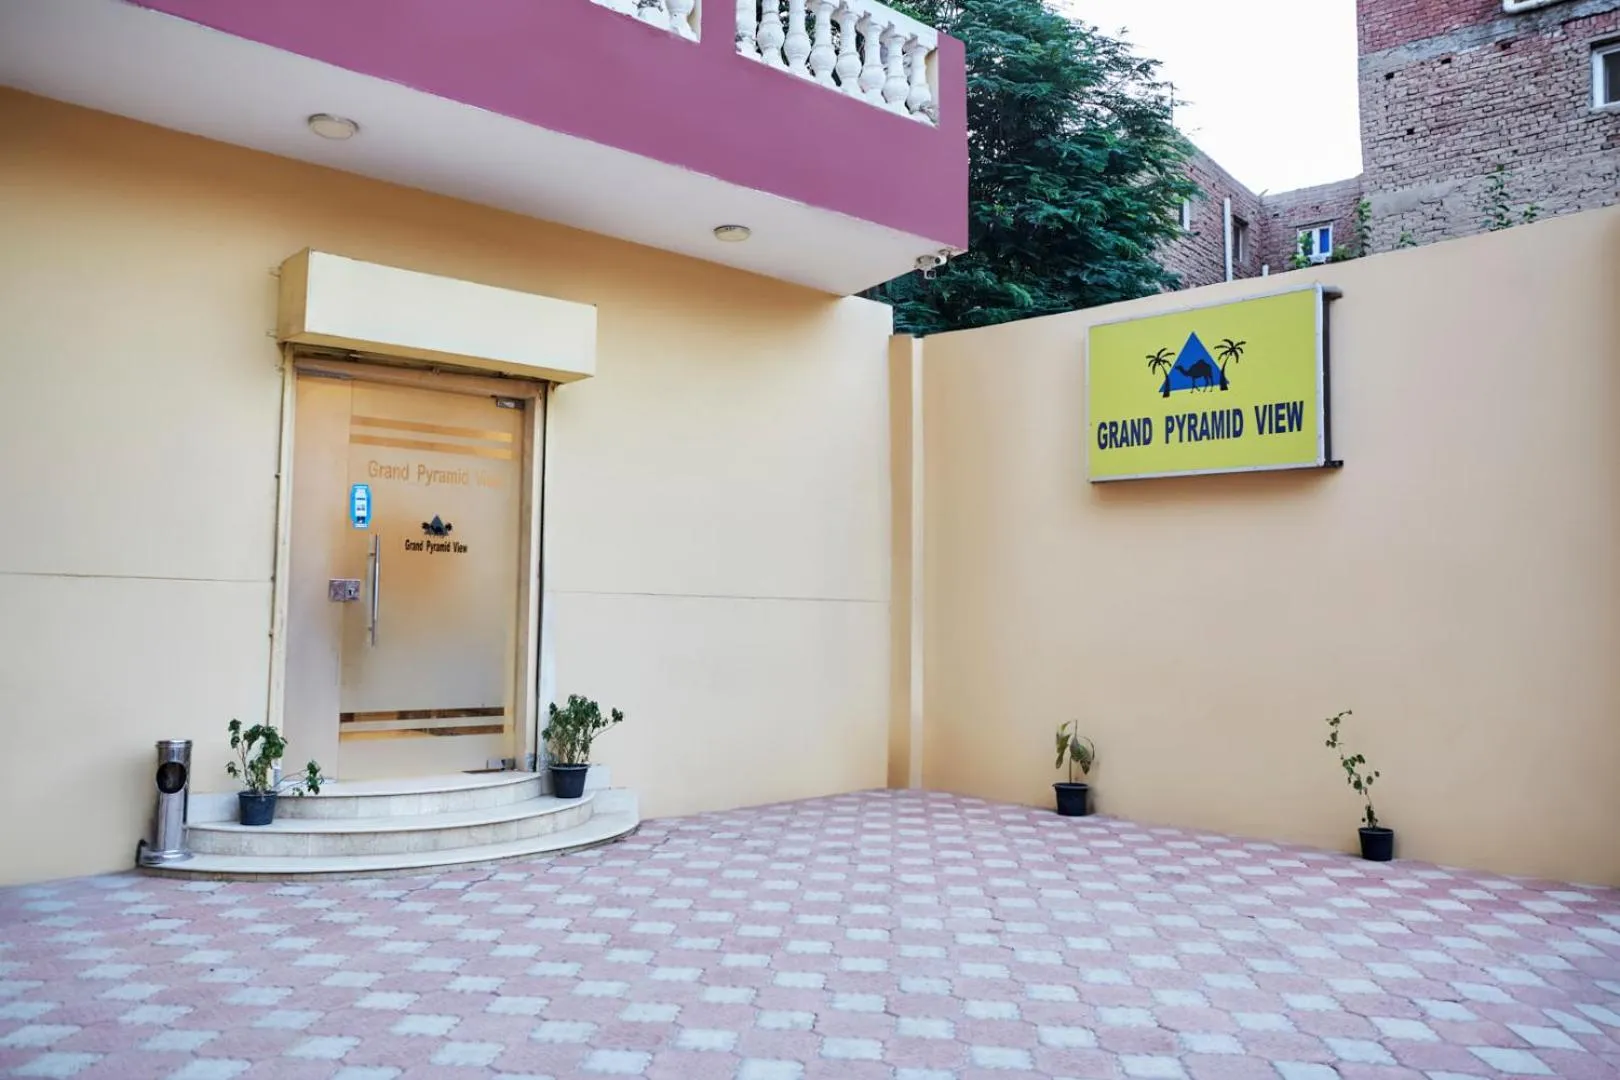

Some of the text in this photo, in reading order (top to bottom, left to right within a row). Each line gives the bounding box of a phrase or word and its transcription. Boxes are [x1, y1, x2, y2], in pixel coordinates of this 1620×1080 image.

[1097, 400, 1304, 450] GRAND PYRAMID VIEW
[368, 460, 410, 480] Grand
[417, 464, 469, 486] Pyramid
[405, 539, 468, 554] Grand Pyramid View
